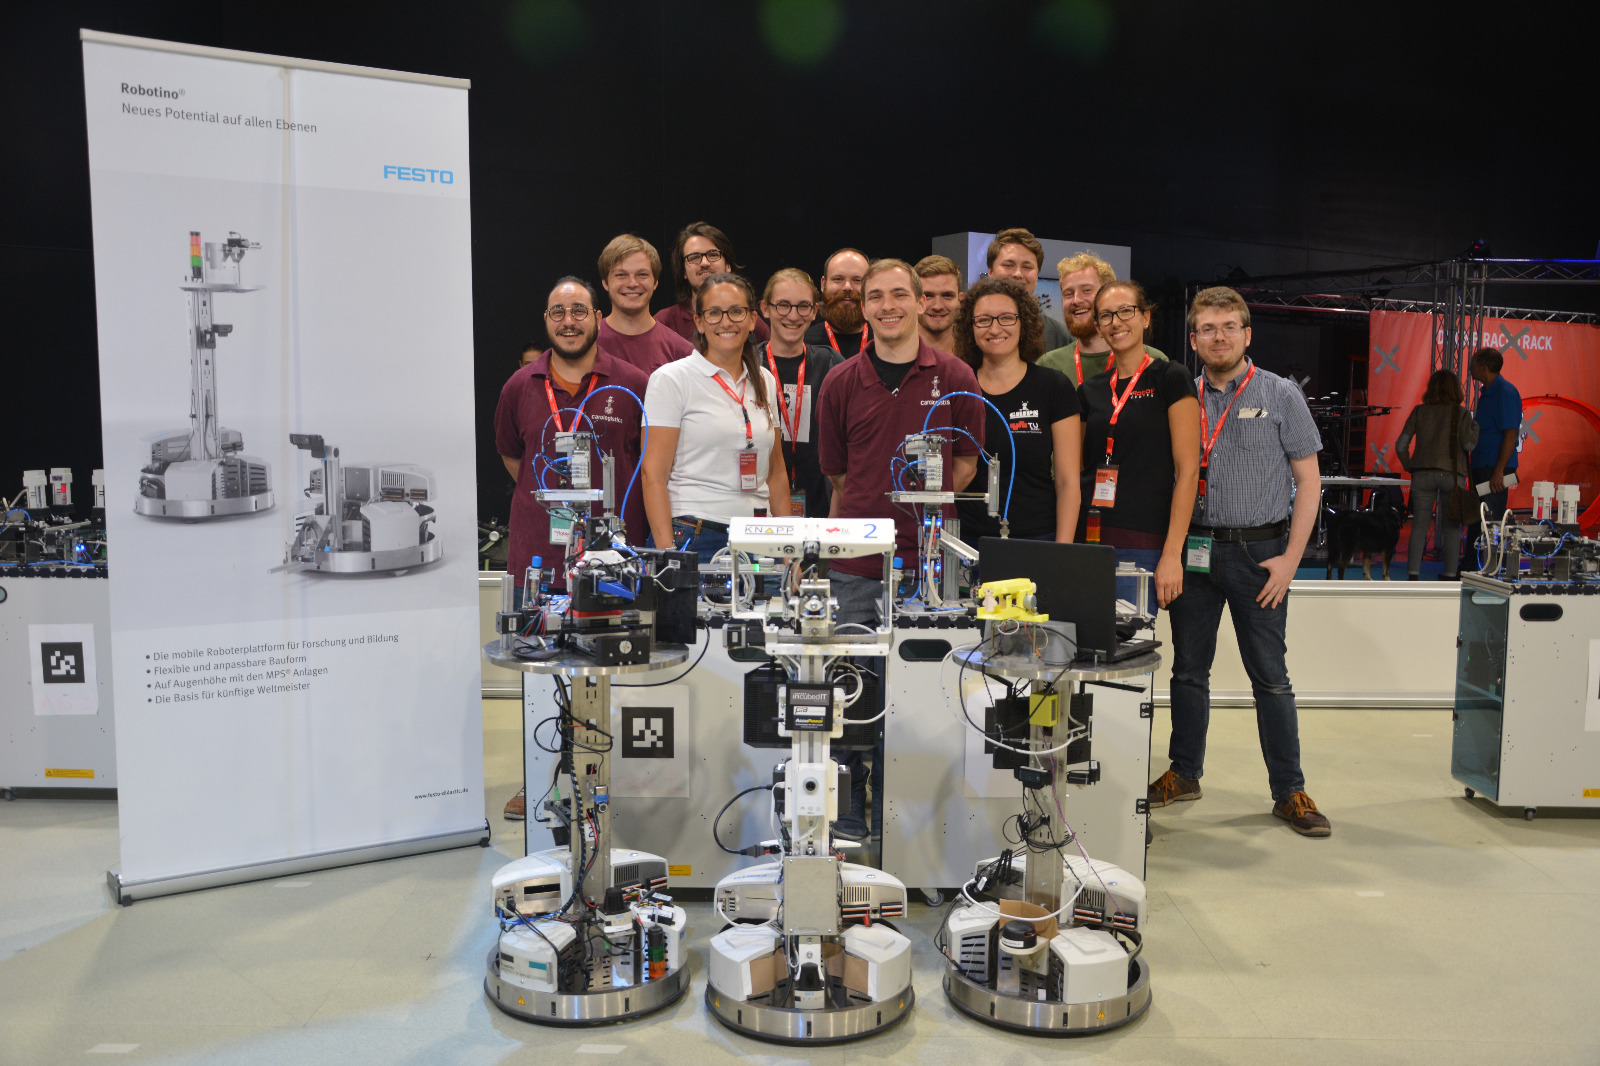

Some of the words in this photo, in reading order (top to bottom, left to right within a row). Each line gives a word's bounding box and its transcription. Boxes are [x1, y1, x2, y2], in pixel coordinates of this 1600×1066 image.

[121, 102, 162, 117] Neues
[165, 107, 219, 123] Potential
[222, 114, 243, 125] auf
[244, 116, 273, 129] allen
[276, 119, 317, 133] Ebenen
[383, 165, 454, 184] FESTO
[745, 525, 794, 535] KNAPP
[863, 523, 878, 539] 2
[153, 651, 169, 661] Die
[172, 649, 204, 659] mobile
[207, 643, 285, 657] Roboterplattform
[287, 641, 300, 650] für
[302, 638, 346, 649] Forschung
[348, 635, 365, 645] und
[367, 634, 399, 643] Bildung
[154, 664, 191, 675] Flexible
[193, 662, 211, 672] und
[213, 658, 267, 671] anpassbare
[269, 655, 307, 666] Bauform
[154, 679, 171, 690] Auf
[173, 676, 227, 688] Augenhöhe
[229, 673, 244, 683] mit
[246, 672, 264, 681] den
[293, 666, 328, 677] Anlagen
[155, 694, 171, 704] Die
[174, 692, 199, 703] Basis
[201, 690, 215, 700] für
[217, 687, 255, 698] künftige
[257, 682, 311, 694] Weltmeister
